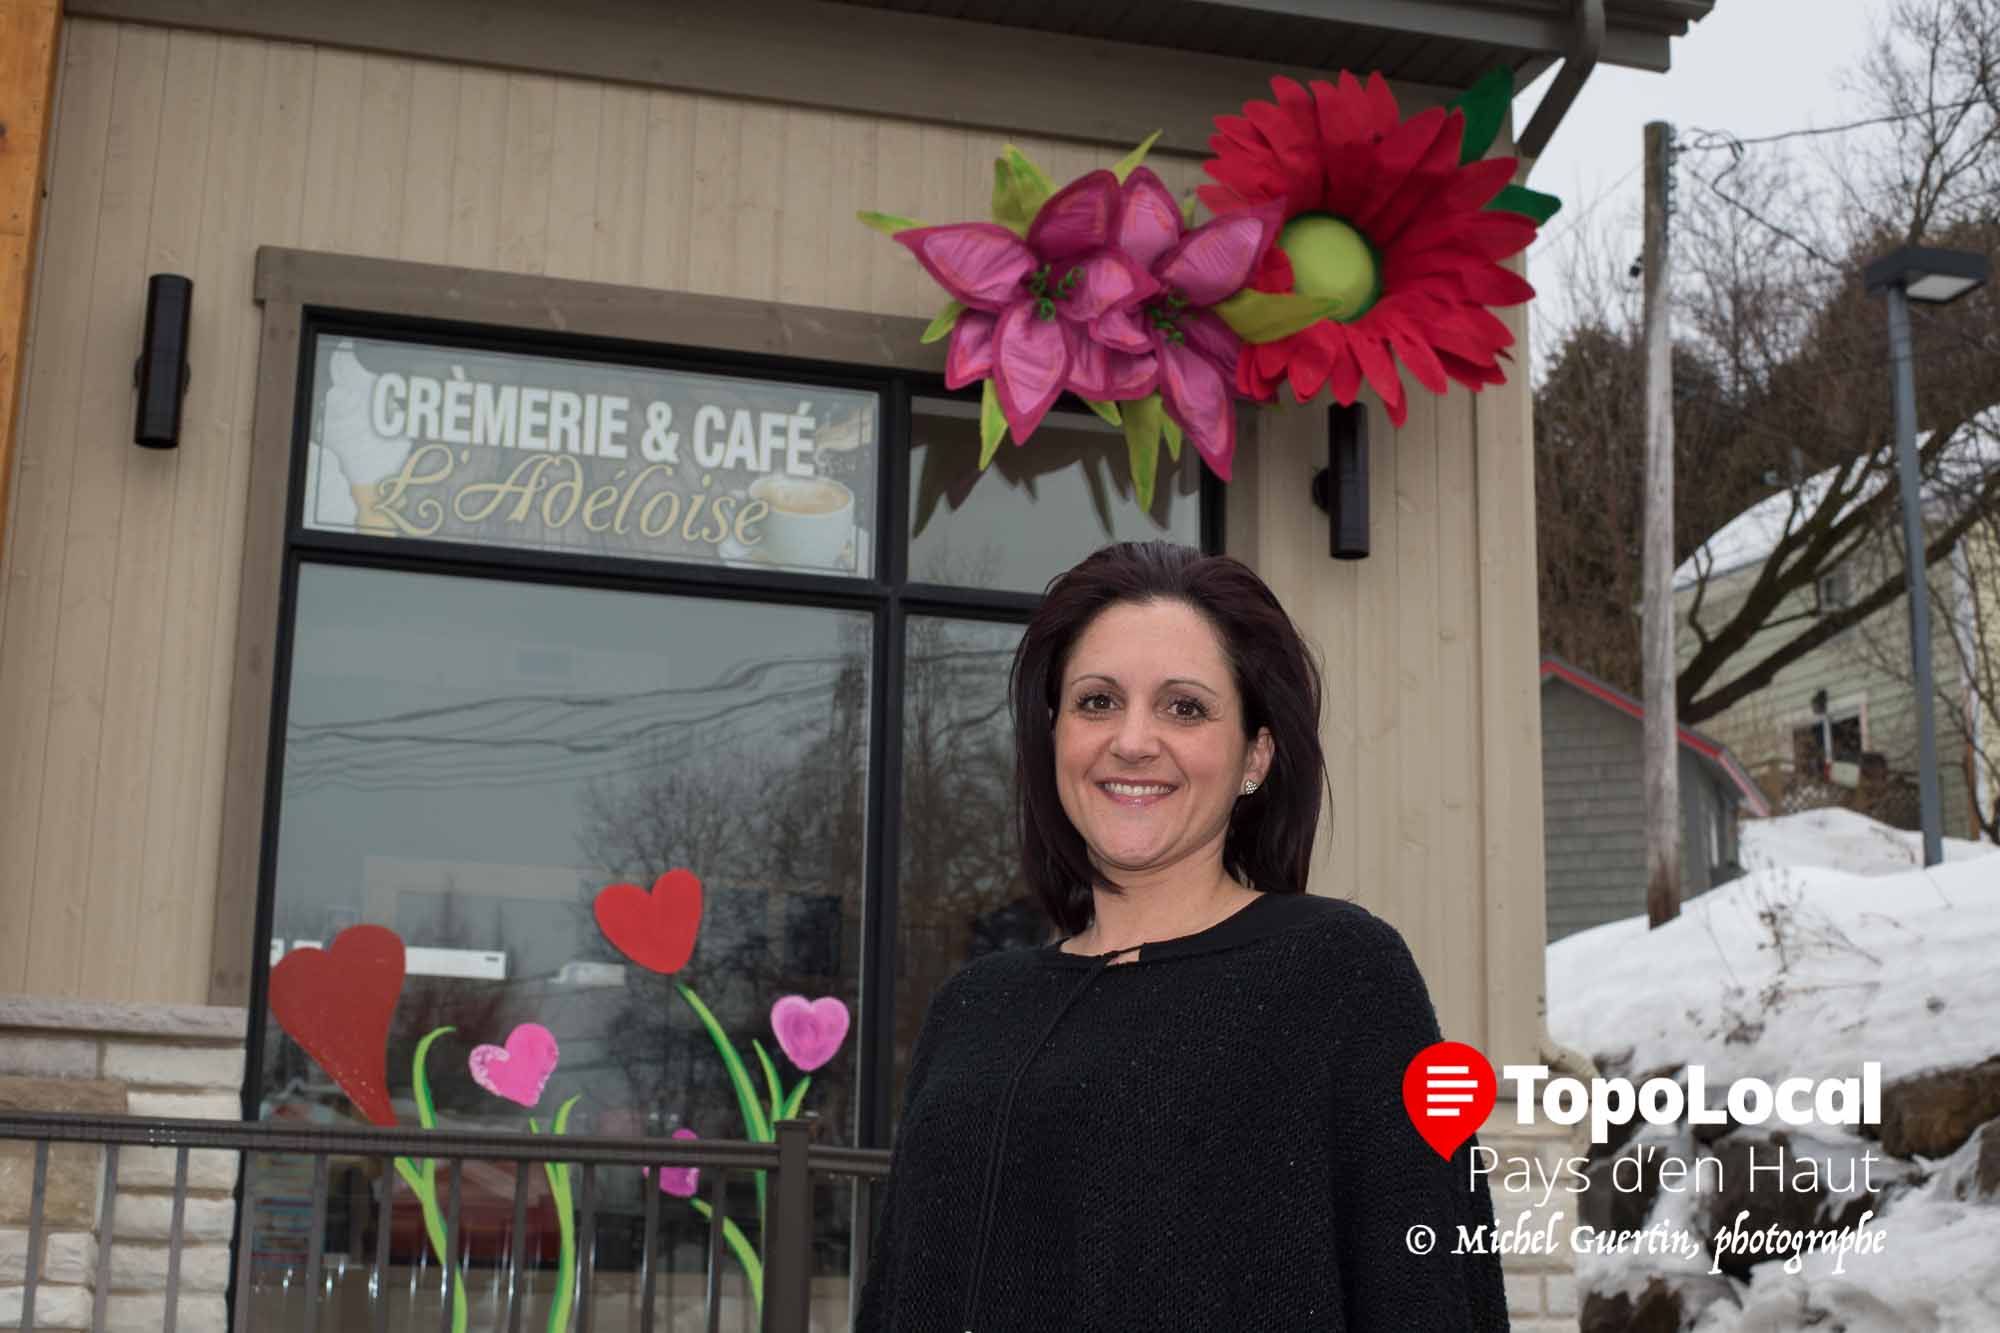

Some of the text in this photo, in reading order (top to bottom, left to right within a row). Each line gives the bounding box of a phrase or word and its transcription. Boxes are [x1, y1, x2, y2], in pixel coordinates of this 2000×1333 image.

[373, 365, 816, 476] CRÈMERIE & CAFÉ
[373, 444, 769, 546] L'Adéloise
